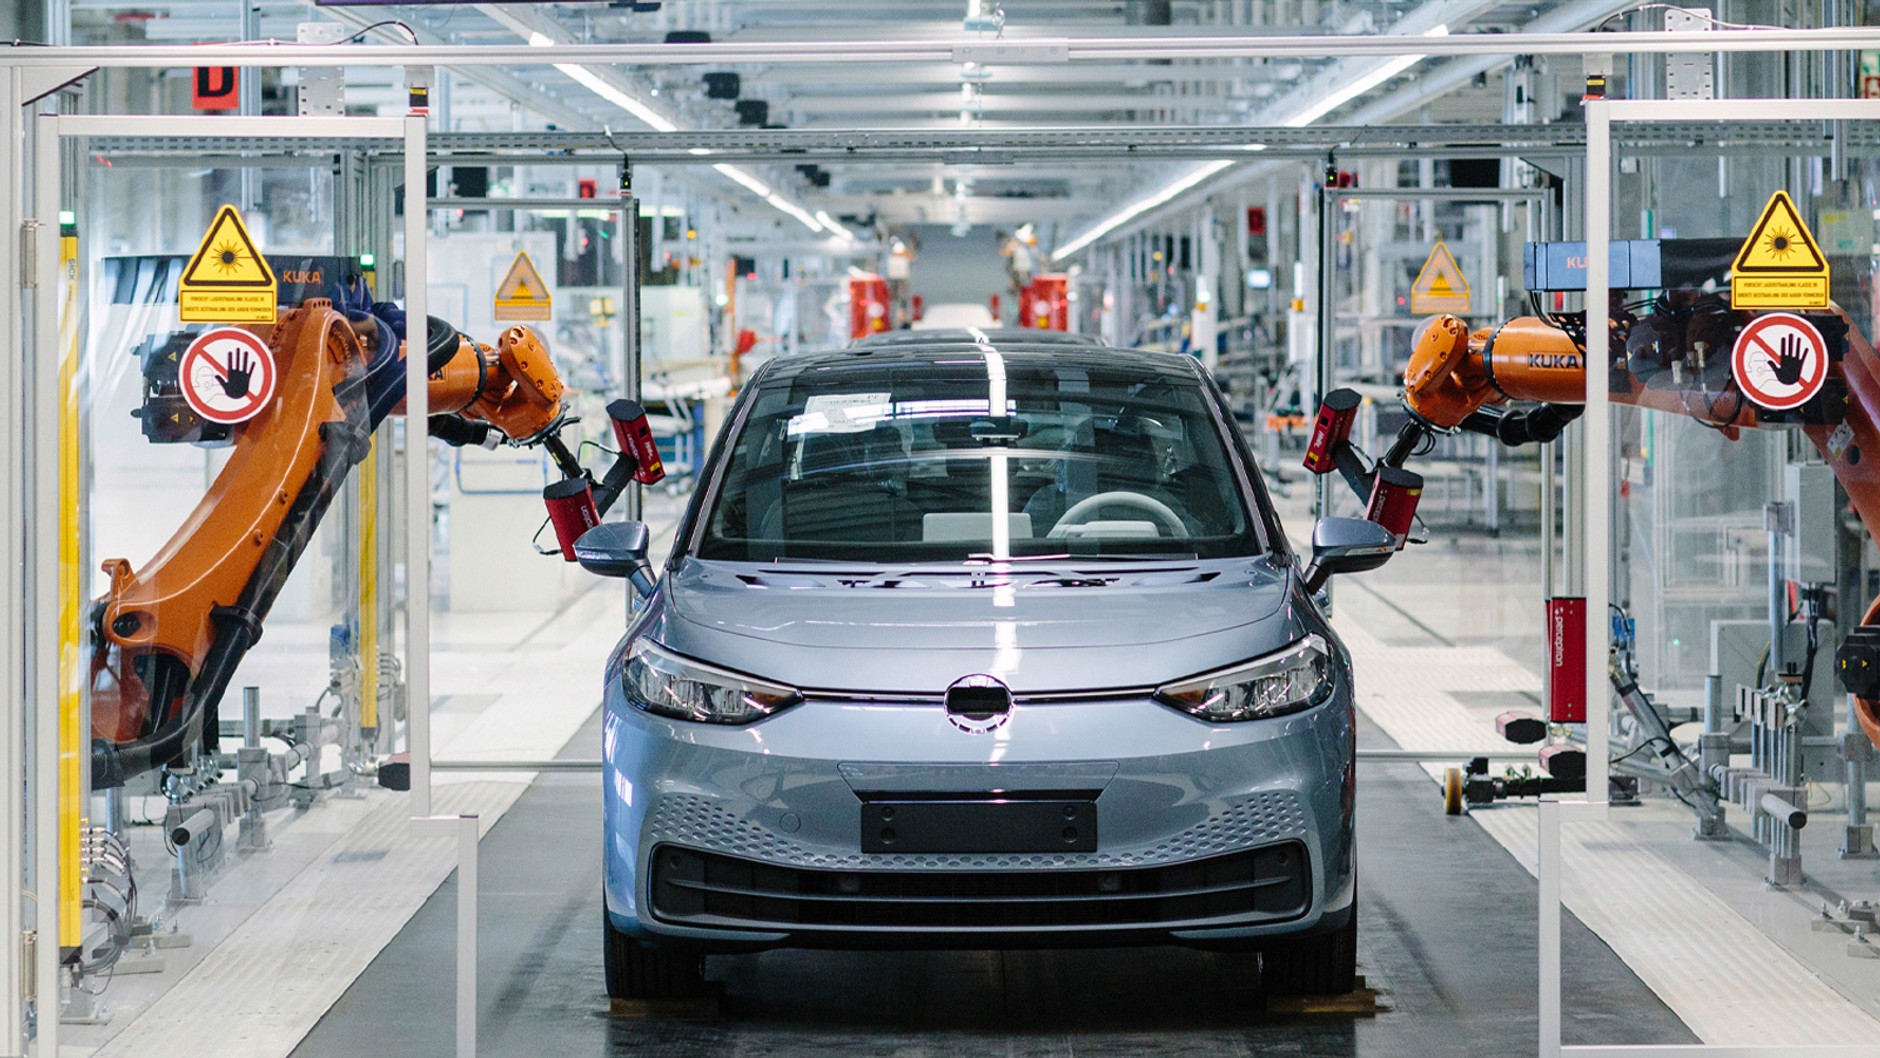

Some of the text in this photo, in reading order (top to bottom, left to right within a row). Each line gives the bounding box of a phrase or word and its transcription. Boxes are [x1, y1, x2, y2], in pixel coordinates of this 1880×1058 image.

[1566, 256, 1588, 269] KU
[283, 271, 321, 284] KUKA
[1529, 353, 1579, 369] KUKA
